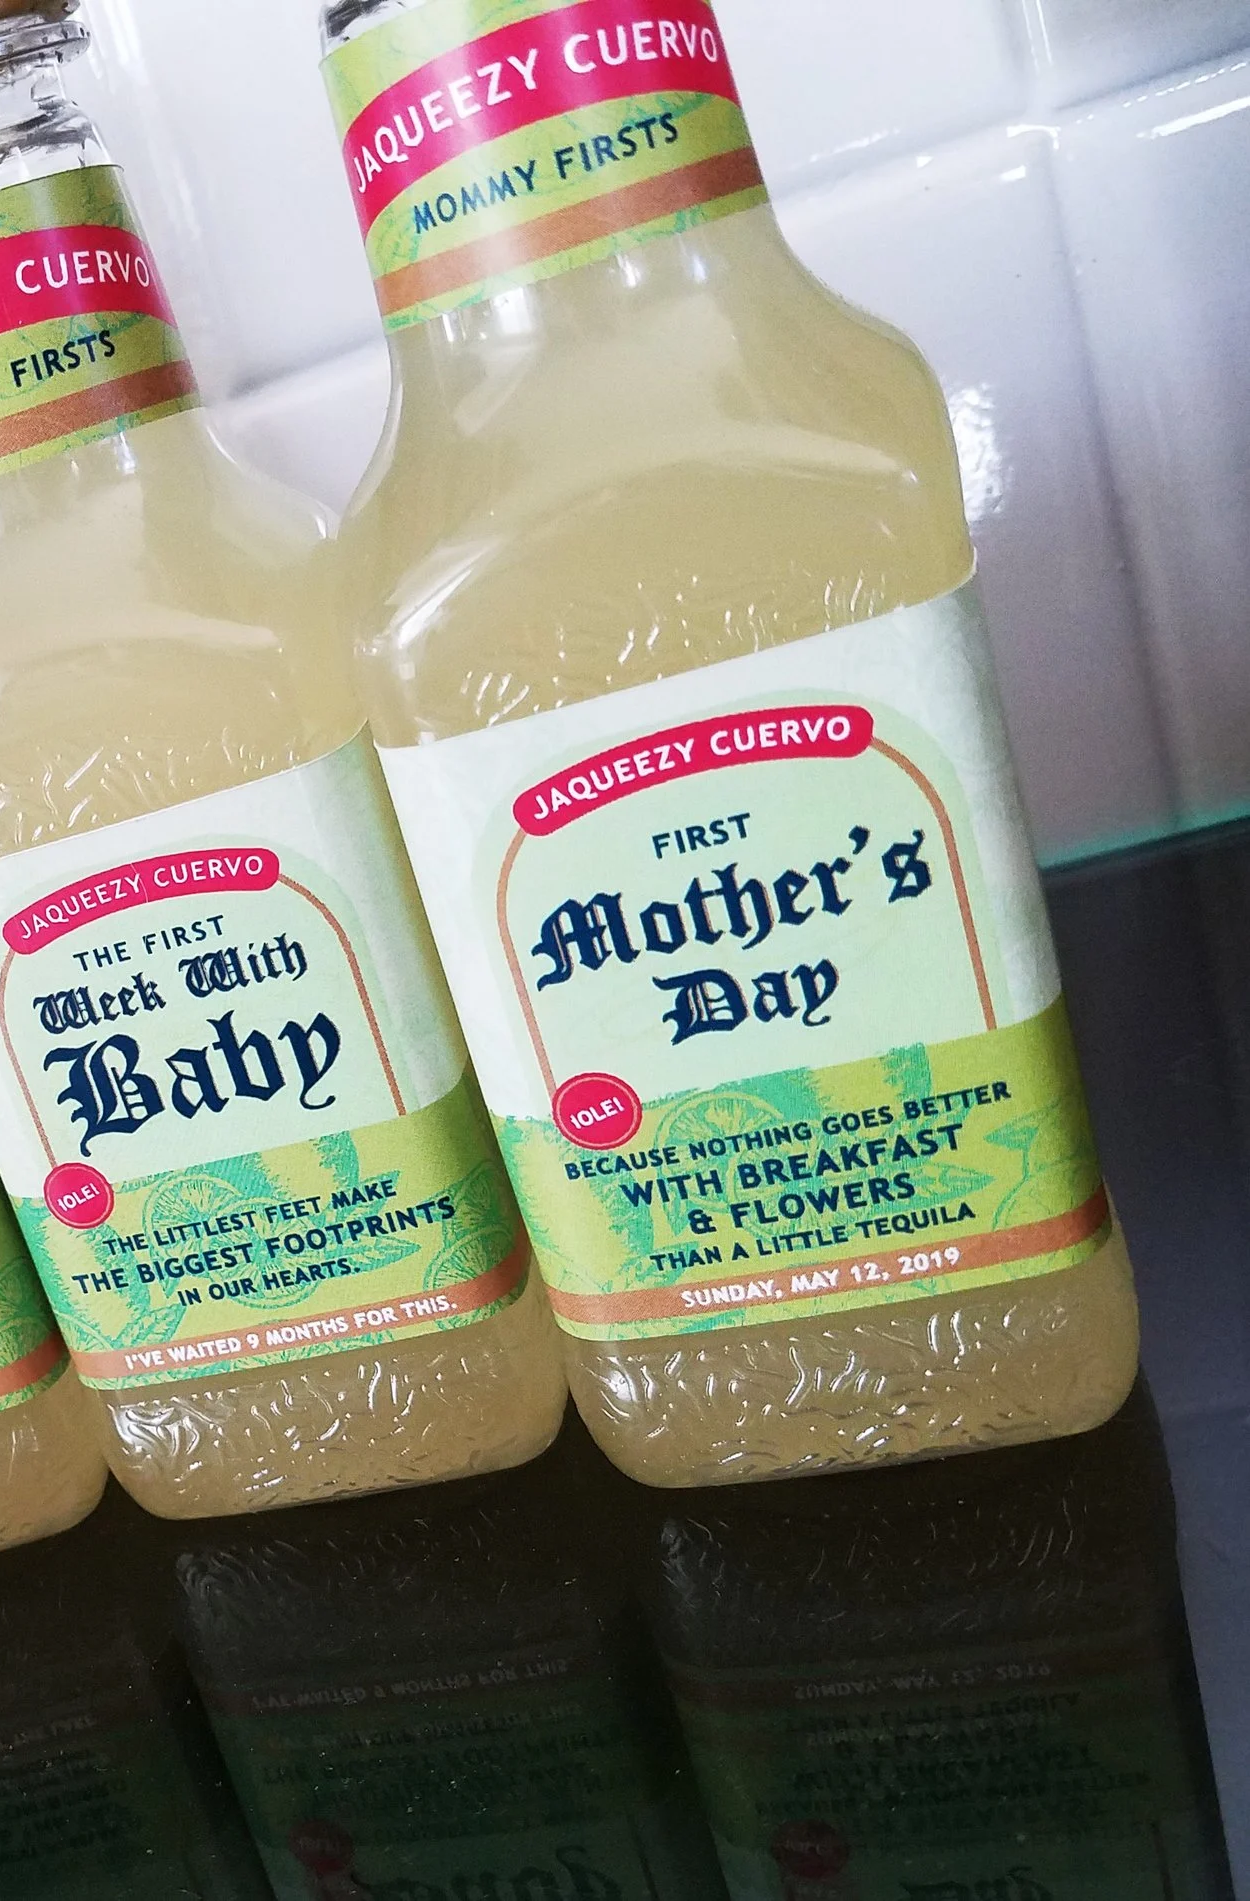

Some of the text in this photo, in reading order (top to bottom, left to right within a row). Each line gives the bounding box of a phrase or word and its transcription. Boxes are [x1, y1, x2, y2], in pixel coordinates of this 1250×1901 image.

[353, 20, 718, 194] JAQUEEZY CUERVO
[413, 112, 678, 234] MOMMY FIRSTS
[15, 250, 150, 294] CUERVO
[10, 330, 115, 387] FIRSTS
[533, 716, 851, 820] JAQUEEZY CUERVO
[652, 813, 750, 860] FIRST
[18, 855, 263, 939] JAQUEEZY CUERVO
[531, 825, 933, 992] Mother's
[32, 932, 308, 1035] Week With
[74, 915, 224, 972] THE FIRST
[652, 958, 839, 1046] Day
[43, 1010, 342, 1157] Baby
[565, 1080, 1012, 1181] BECAUSE NOTHING GOES BETTER
[620, 1123, 963, 1207] WITH BREAKFAST
[103, 1179, 398, 1256] THE LITTLEST FEET MAKE
[650, 1202, 975, 1272] THAN A LITTLE TEQUILA
[687, 1171, 916, 1235] & FLOWERS
[72, 1196, 456, 1295] THE BIGGEST FOOTPRINTS
[177, 1257, 361, 1307] IN OUR HEARTS.
[681, 1247, 961, 1308] SUNDAY, MAY 12, 2019
[125, 1294, 458, 1369] I'VE WAITED 9 MONTHS FOR THIS.
